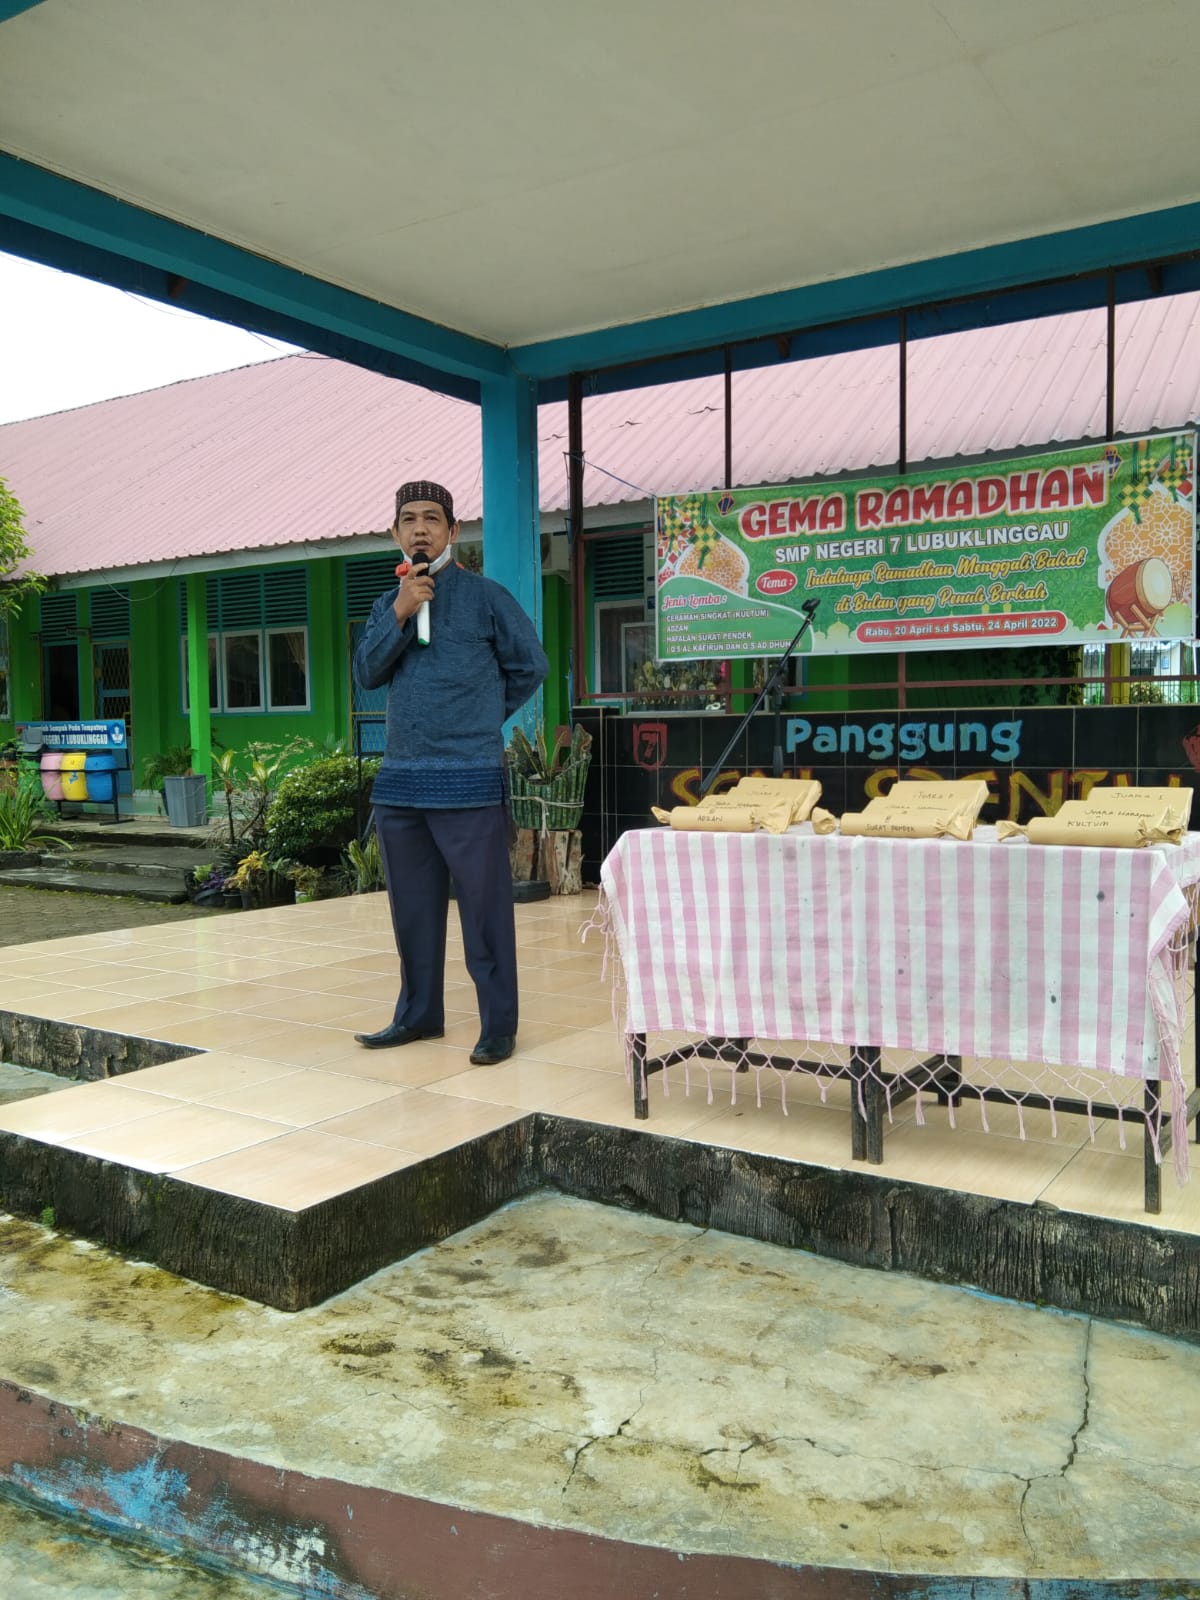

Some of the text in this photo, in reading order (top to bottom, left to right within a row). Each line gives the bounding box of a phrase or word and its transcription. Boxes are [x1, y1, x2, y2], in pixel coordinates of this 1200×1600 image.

[739, 465, 1108, 540] GEMA RAMADHAN
[775, 521, 1070, 563] SMP NEGERI 7 LUBUKLINGGAU
[806, 547, 1087, 588] Indahnya Ramadhan Menggali Bakat
[760, 575, 787, 589] Tema
[662, 595, 687, 611] Jenis
[688, 593, 720, 609] Lomba
[836, 580, 1048, 615] di Bulan yang Penuh Berkah
[667, 613, 698, 622] CERAMAH
[700, 611, 731, 620] SINGKAT
[698, 632, 720, 641] SURAT
[723, 631, 752, 640] PENDEK
[864, 617, 1057, 638] Rabu, 20 April s.d Sabtu, 24 April 2022
[693, 643, 723, 652] KAFIRUN
[726, 642, 740, 650] DAN
[757, 641, 767, 649] AD
[786, 718, 1023, 762] Panggung
